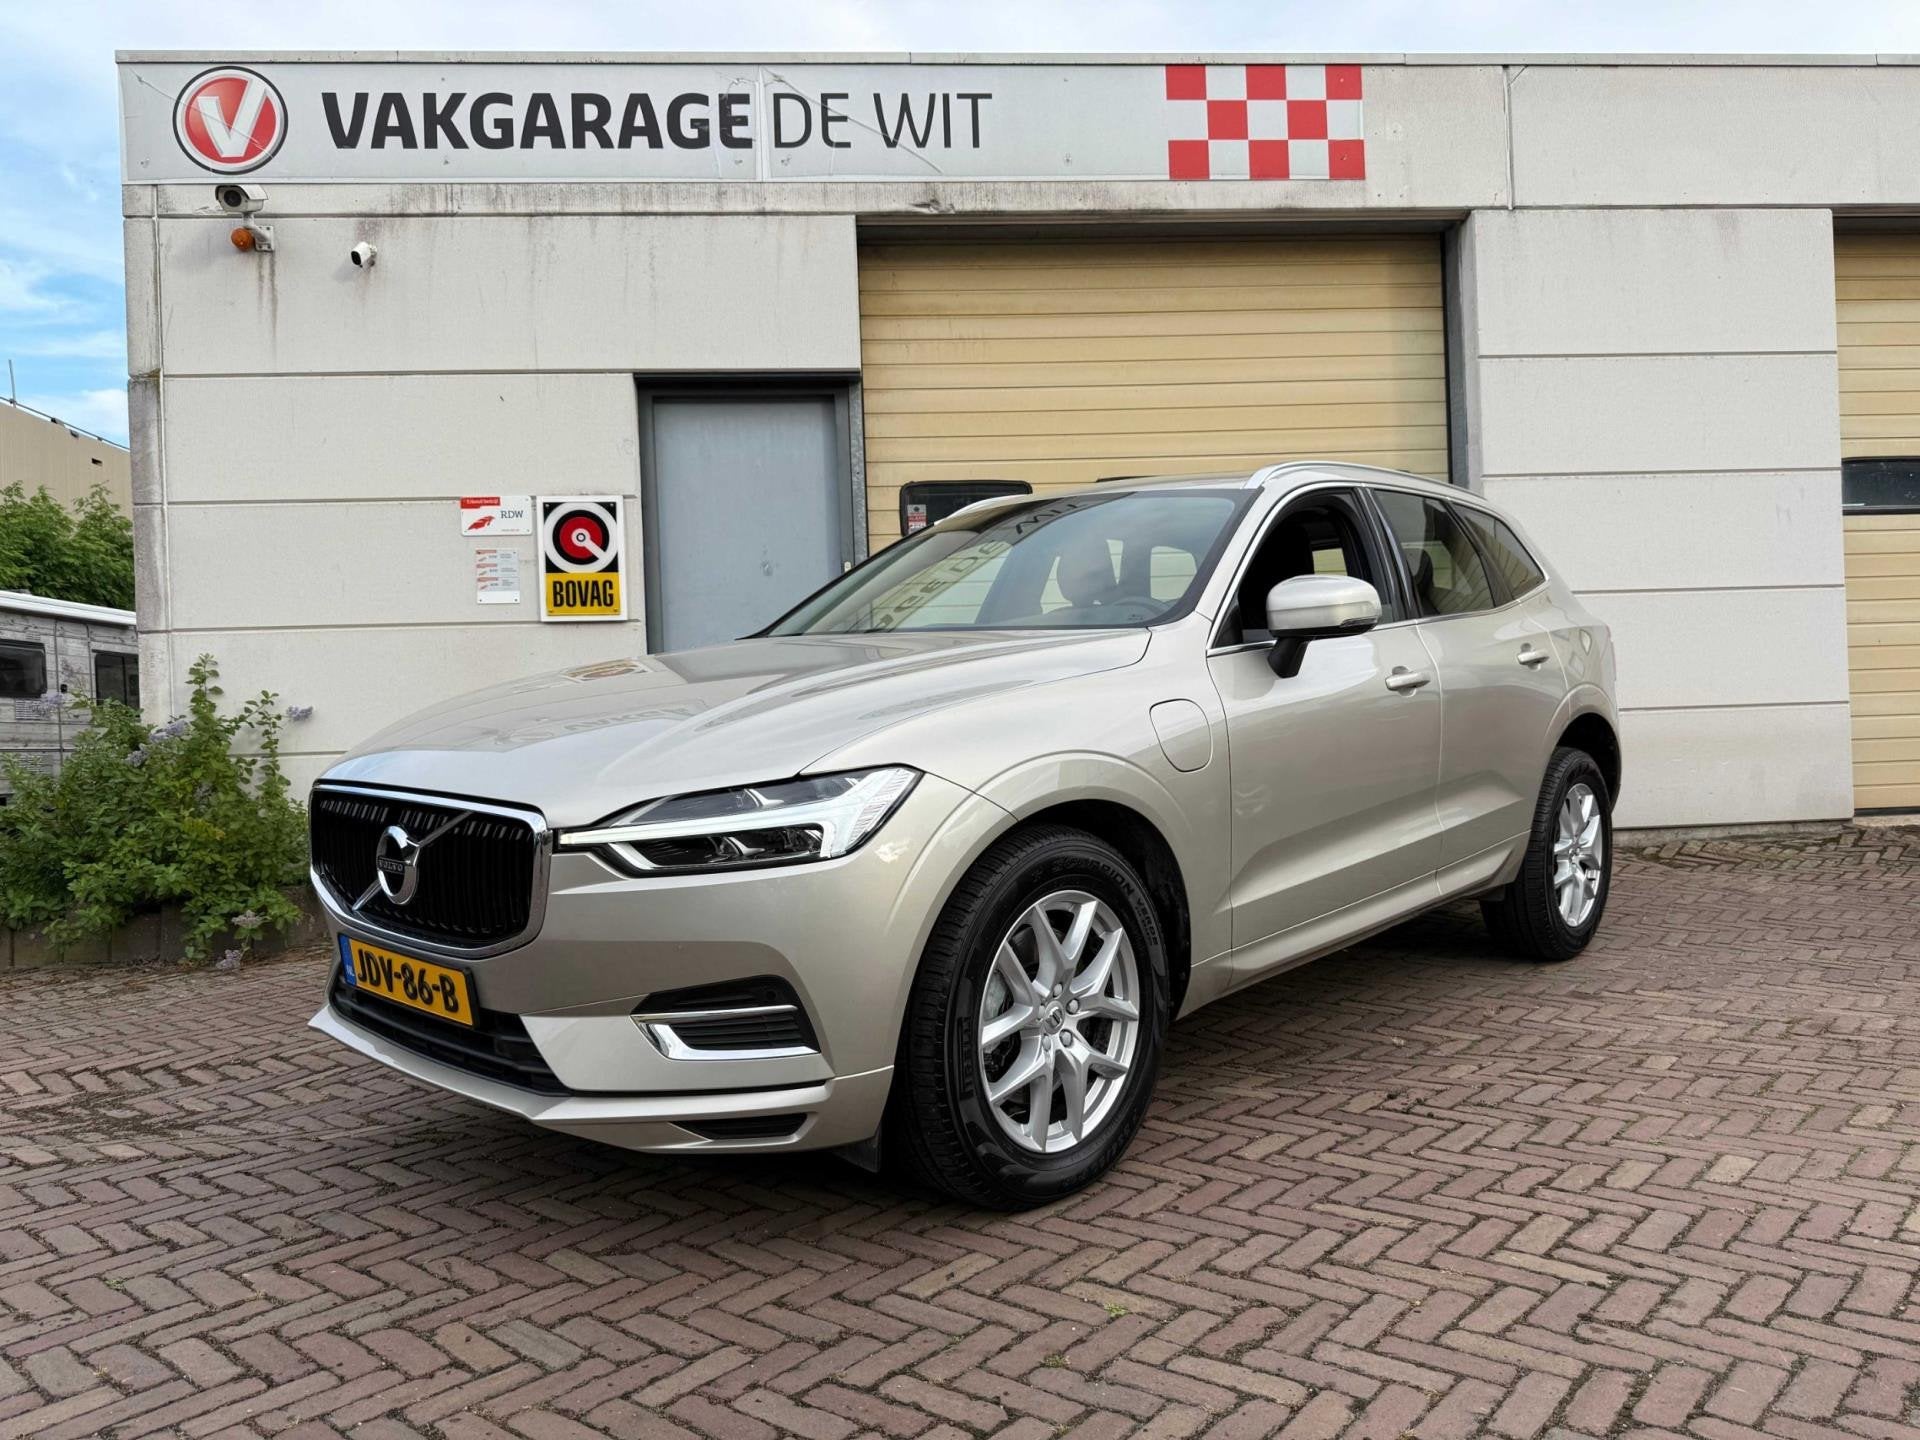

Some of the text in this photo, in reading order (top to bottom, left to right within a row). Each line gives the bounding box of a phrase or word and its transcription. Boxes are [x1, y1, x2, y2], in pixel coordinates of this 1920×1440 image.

[321, 92, 992, 150] VAKGARAGE DE WIT
[500, 510, 524, 519] RDW
[552, 579, 614, 608] BOVAG
[378, 859, 404, 872] VOLVO
[357, 948, 460, 1013] JDV-86-B
